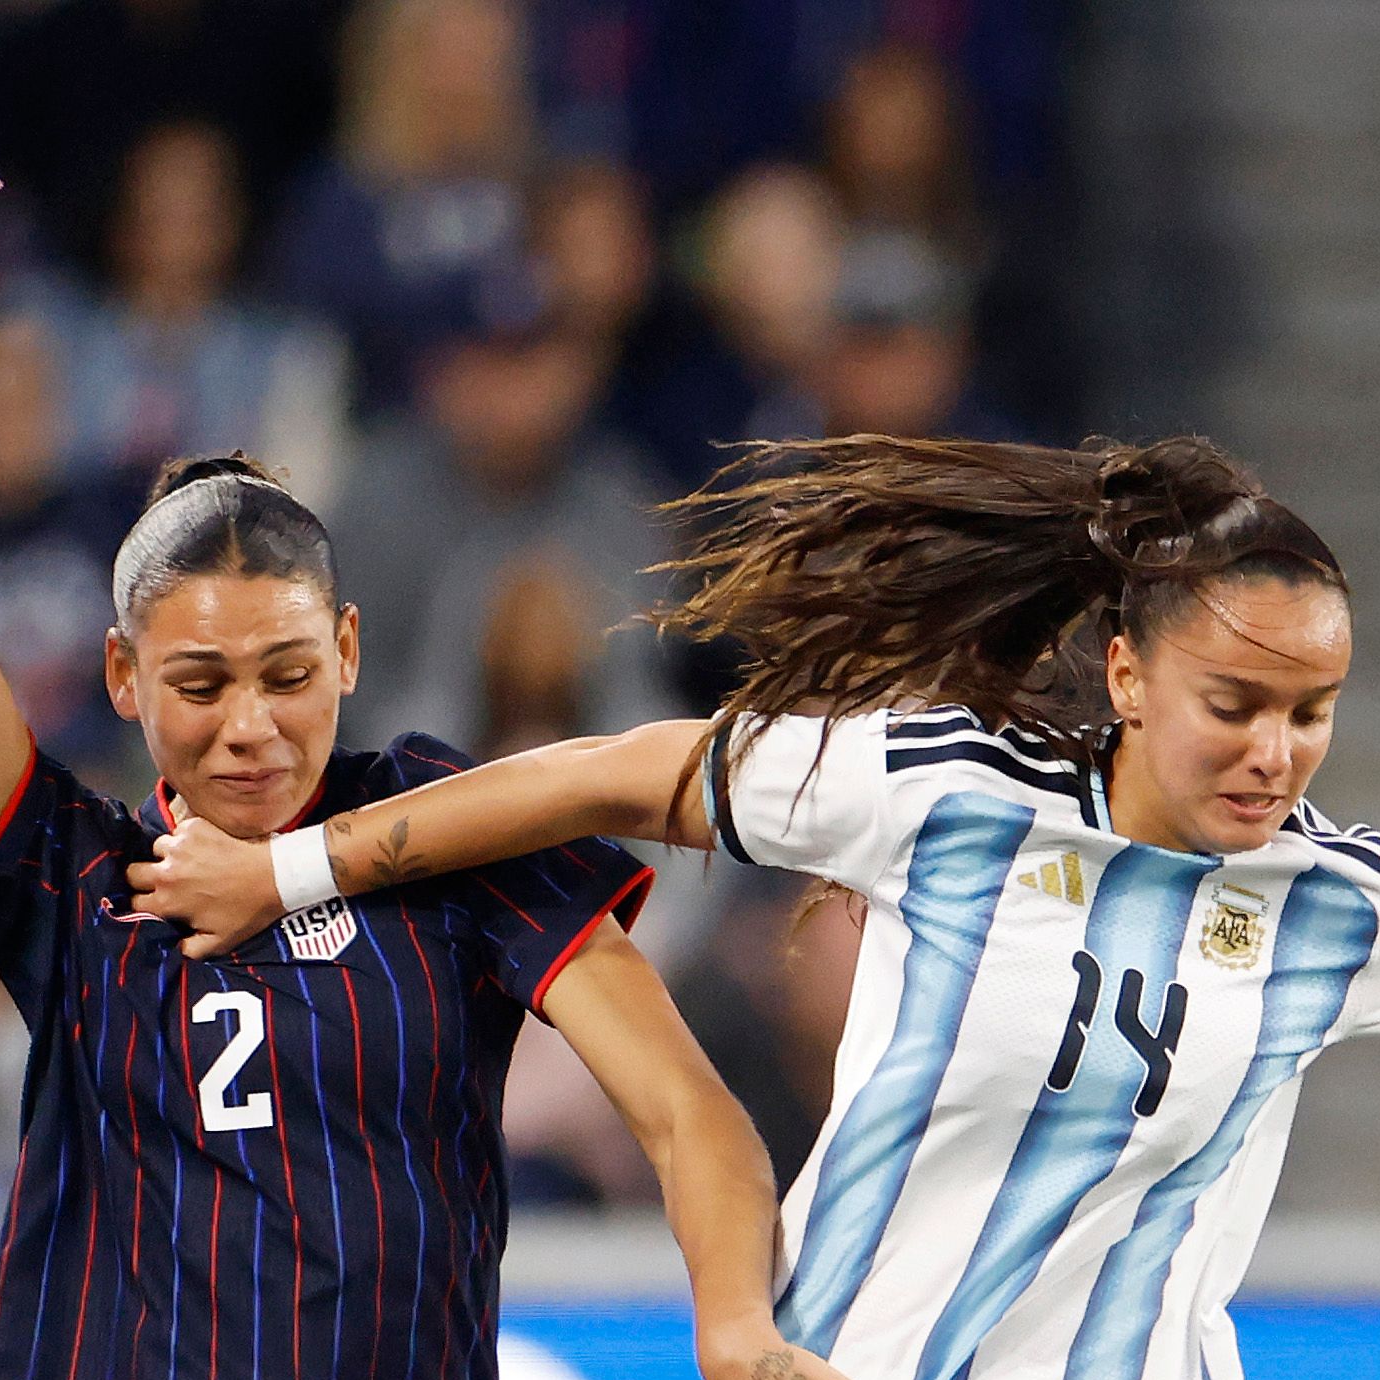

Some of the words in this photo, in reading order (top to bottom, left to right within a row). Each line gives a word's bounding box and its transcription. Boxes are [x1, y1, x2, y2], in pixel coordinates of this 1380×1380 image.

[286, 895, 345, 938] USA
[191, 990, 274, 1132] 2
[1046, 949, 1189, 1119] 14
